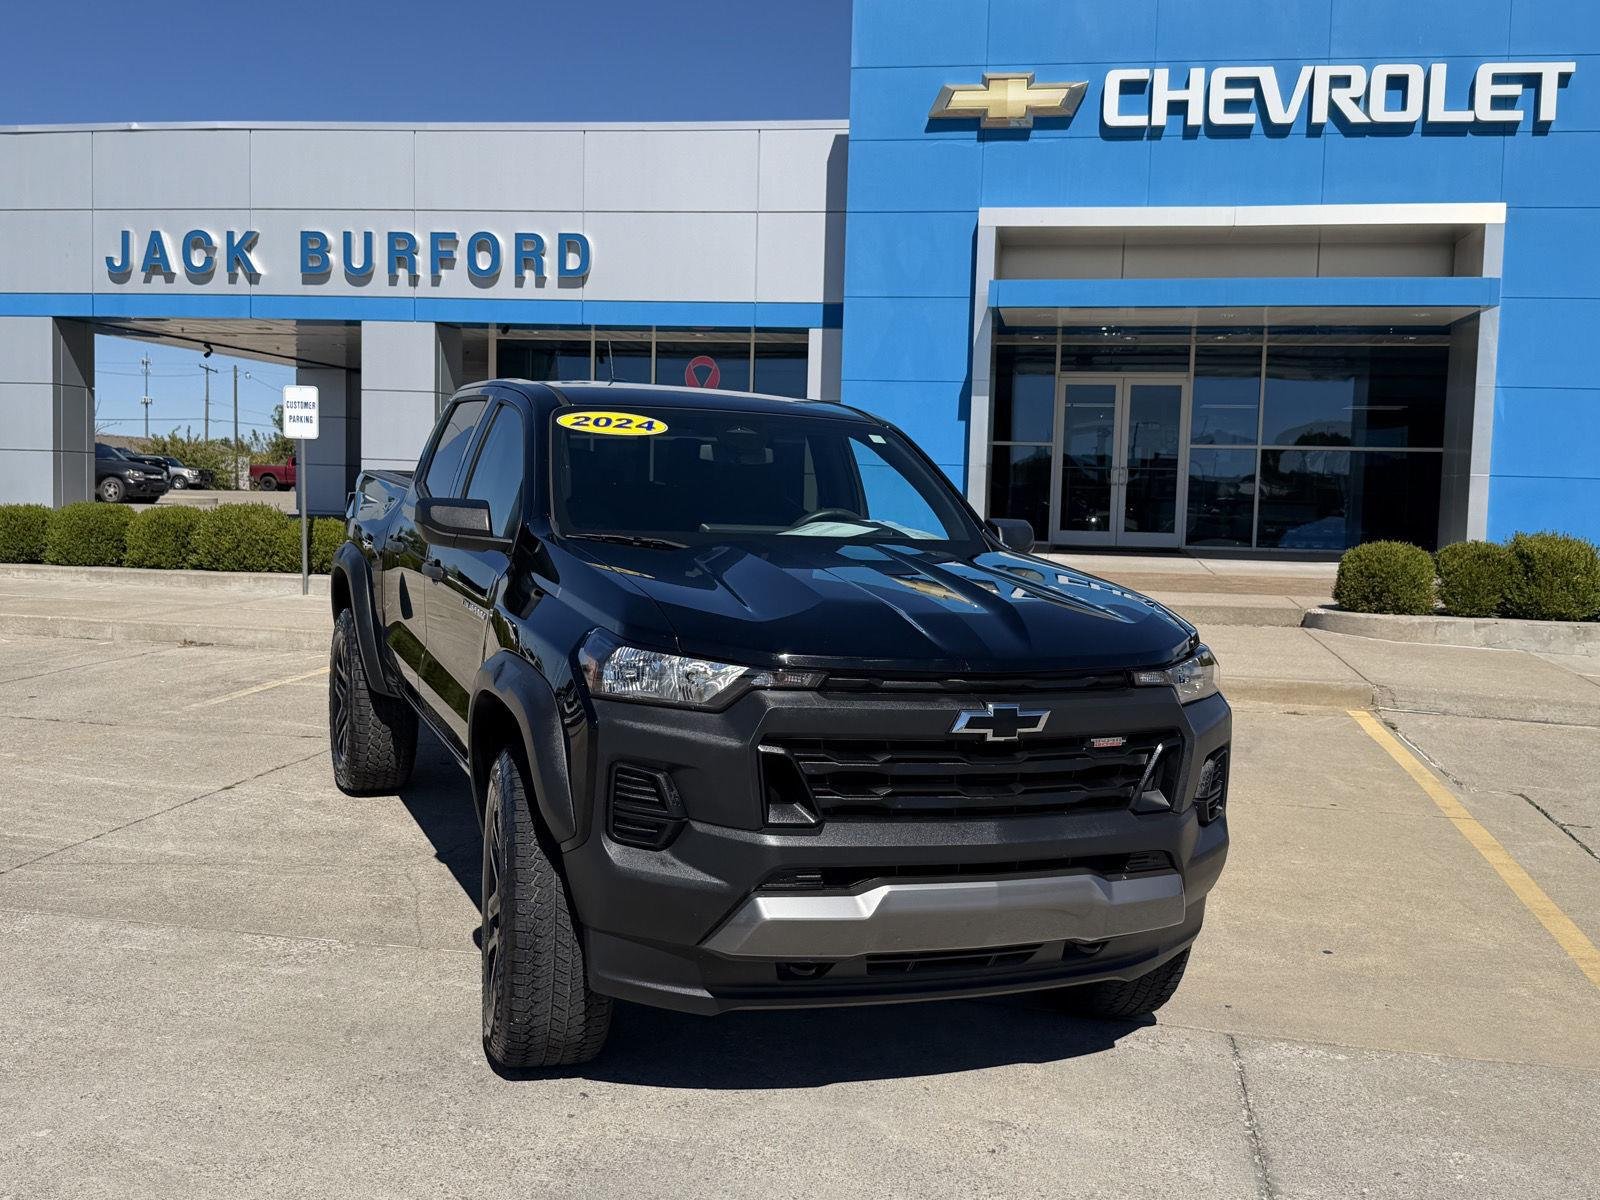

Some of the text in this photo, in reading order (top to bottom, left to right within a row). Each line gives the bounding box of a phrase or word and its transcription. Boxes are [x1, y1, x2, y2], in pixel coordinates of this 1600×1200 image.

[1102, 61, 1577, 127] CHEVROLET
[105, 229, 591, 278] JACK BURFORD
[286, 400, 316, 409] CUSTOMER
[288, 415, 313, 424] PARKING
[570, 416, 656, 431] 2024
